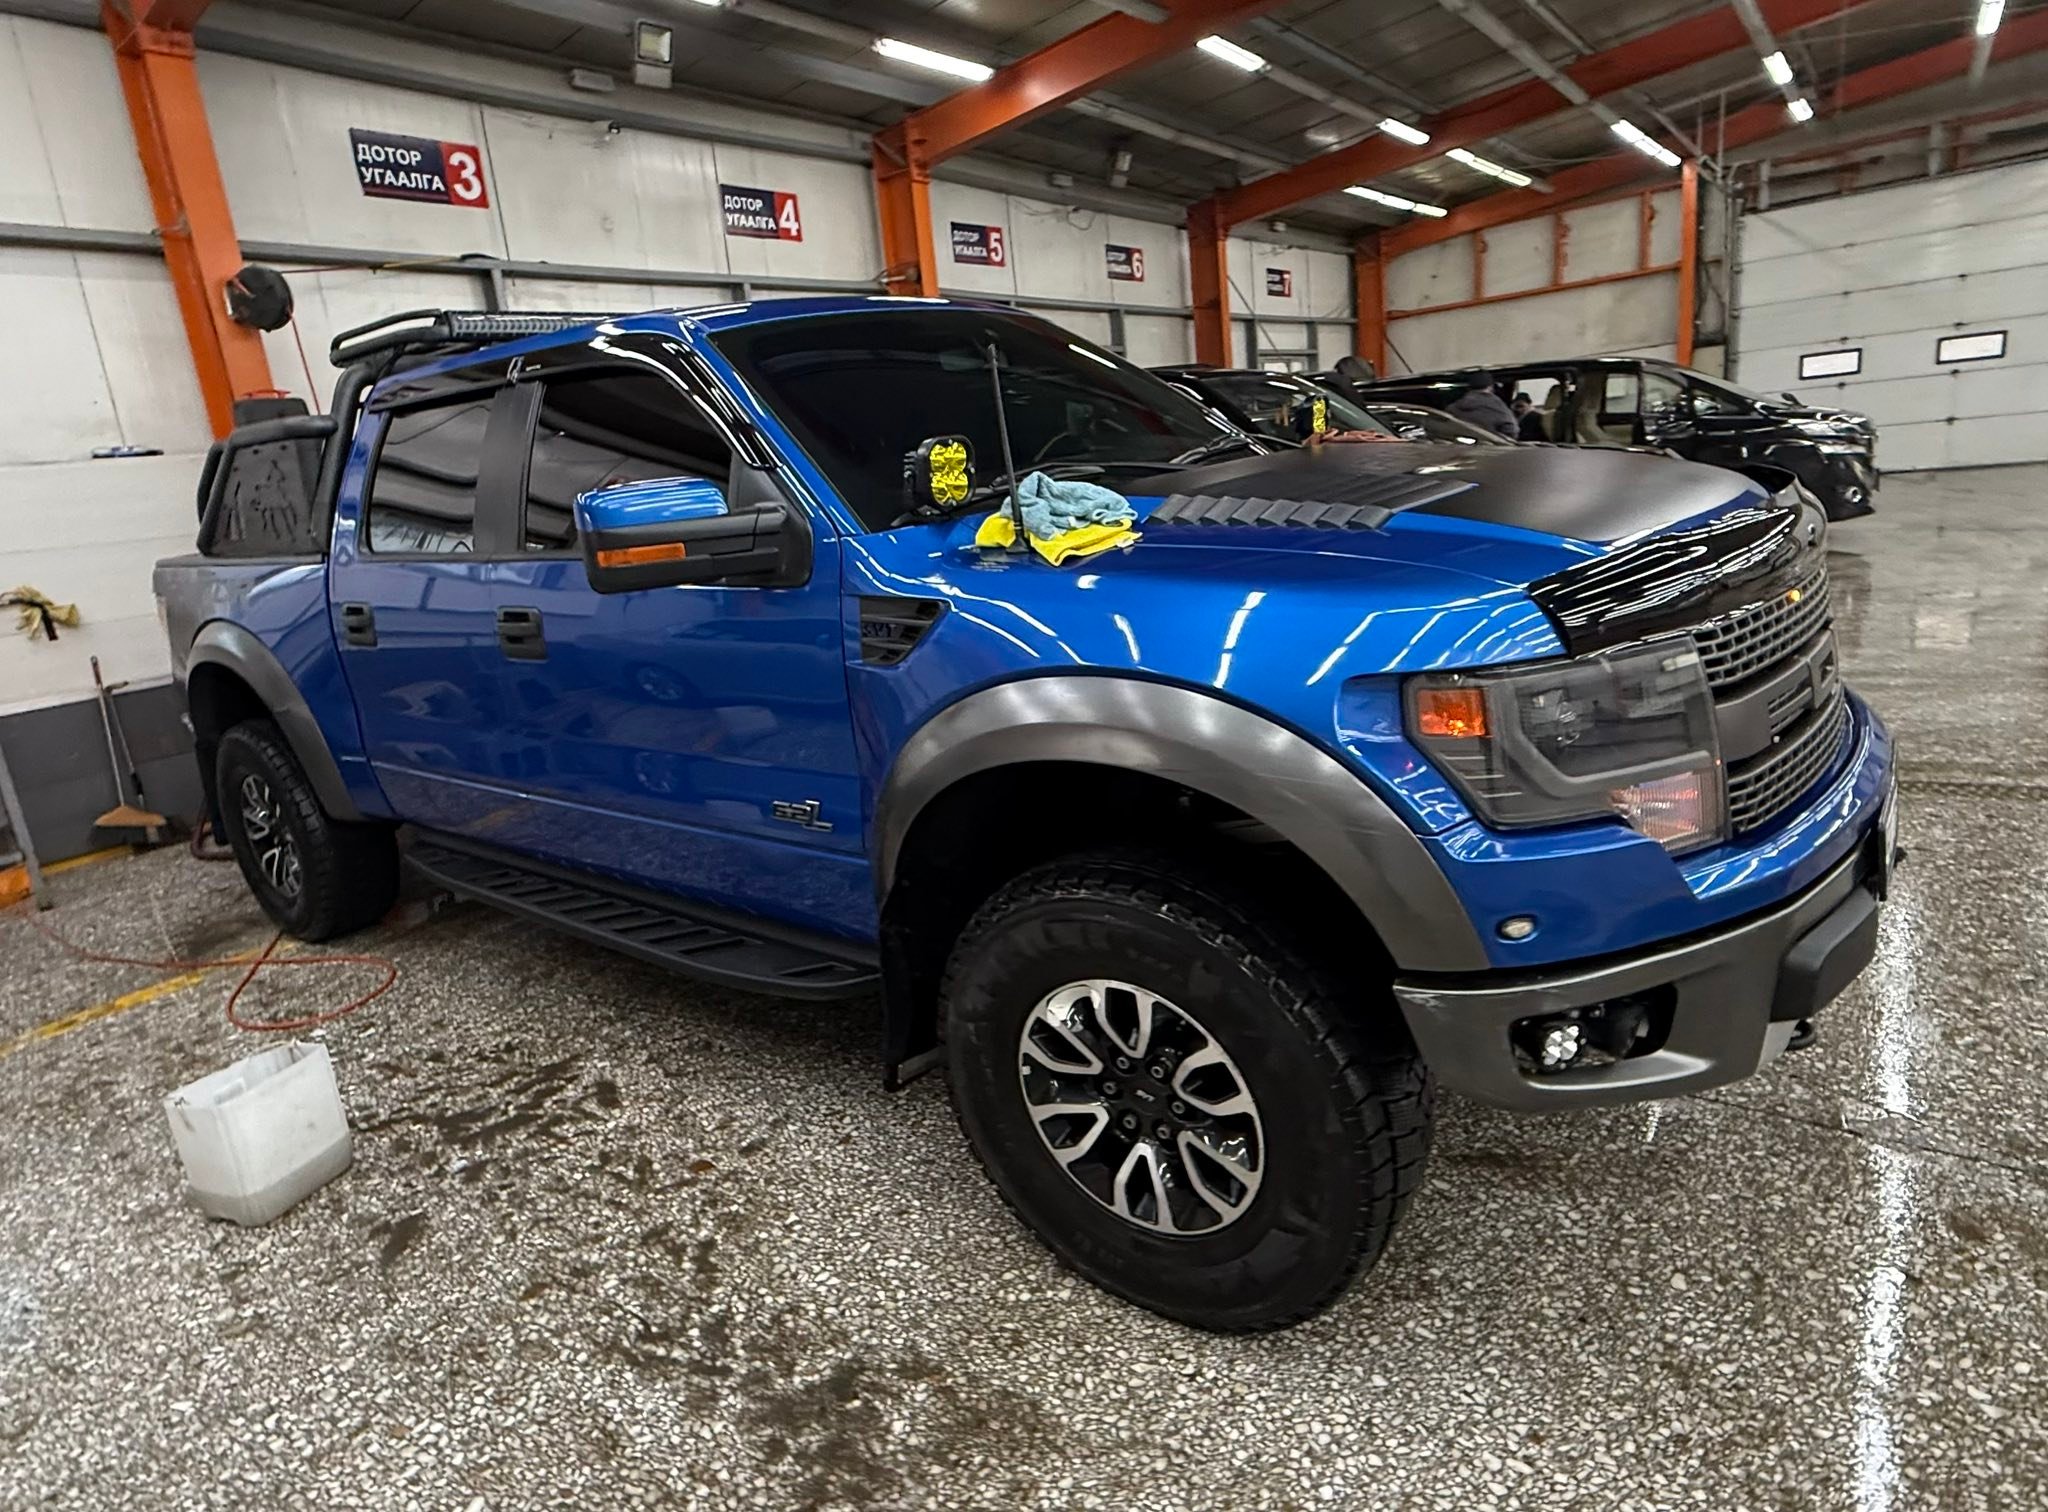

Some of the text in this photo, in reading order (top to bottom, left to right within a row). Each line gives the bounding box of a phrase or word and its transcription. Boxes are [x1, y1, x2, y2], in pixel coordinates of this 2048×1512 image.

[357, 143, 422, 166] ДОТОР
[360, 166, 445, 192] УГААЛГА
[449, 151, 482, 200] 3
[724, 195, 763, 211] ДОТОР
[726, 213, 777, 230] УГААЛГА
[780, 199, 799, 236] 4
[990, 232, 1003, 262] 5
[1132, 252, 1142, 278] 6
